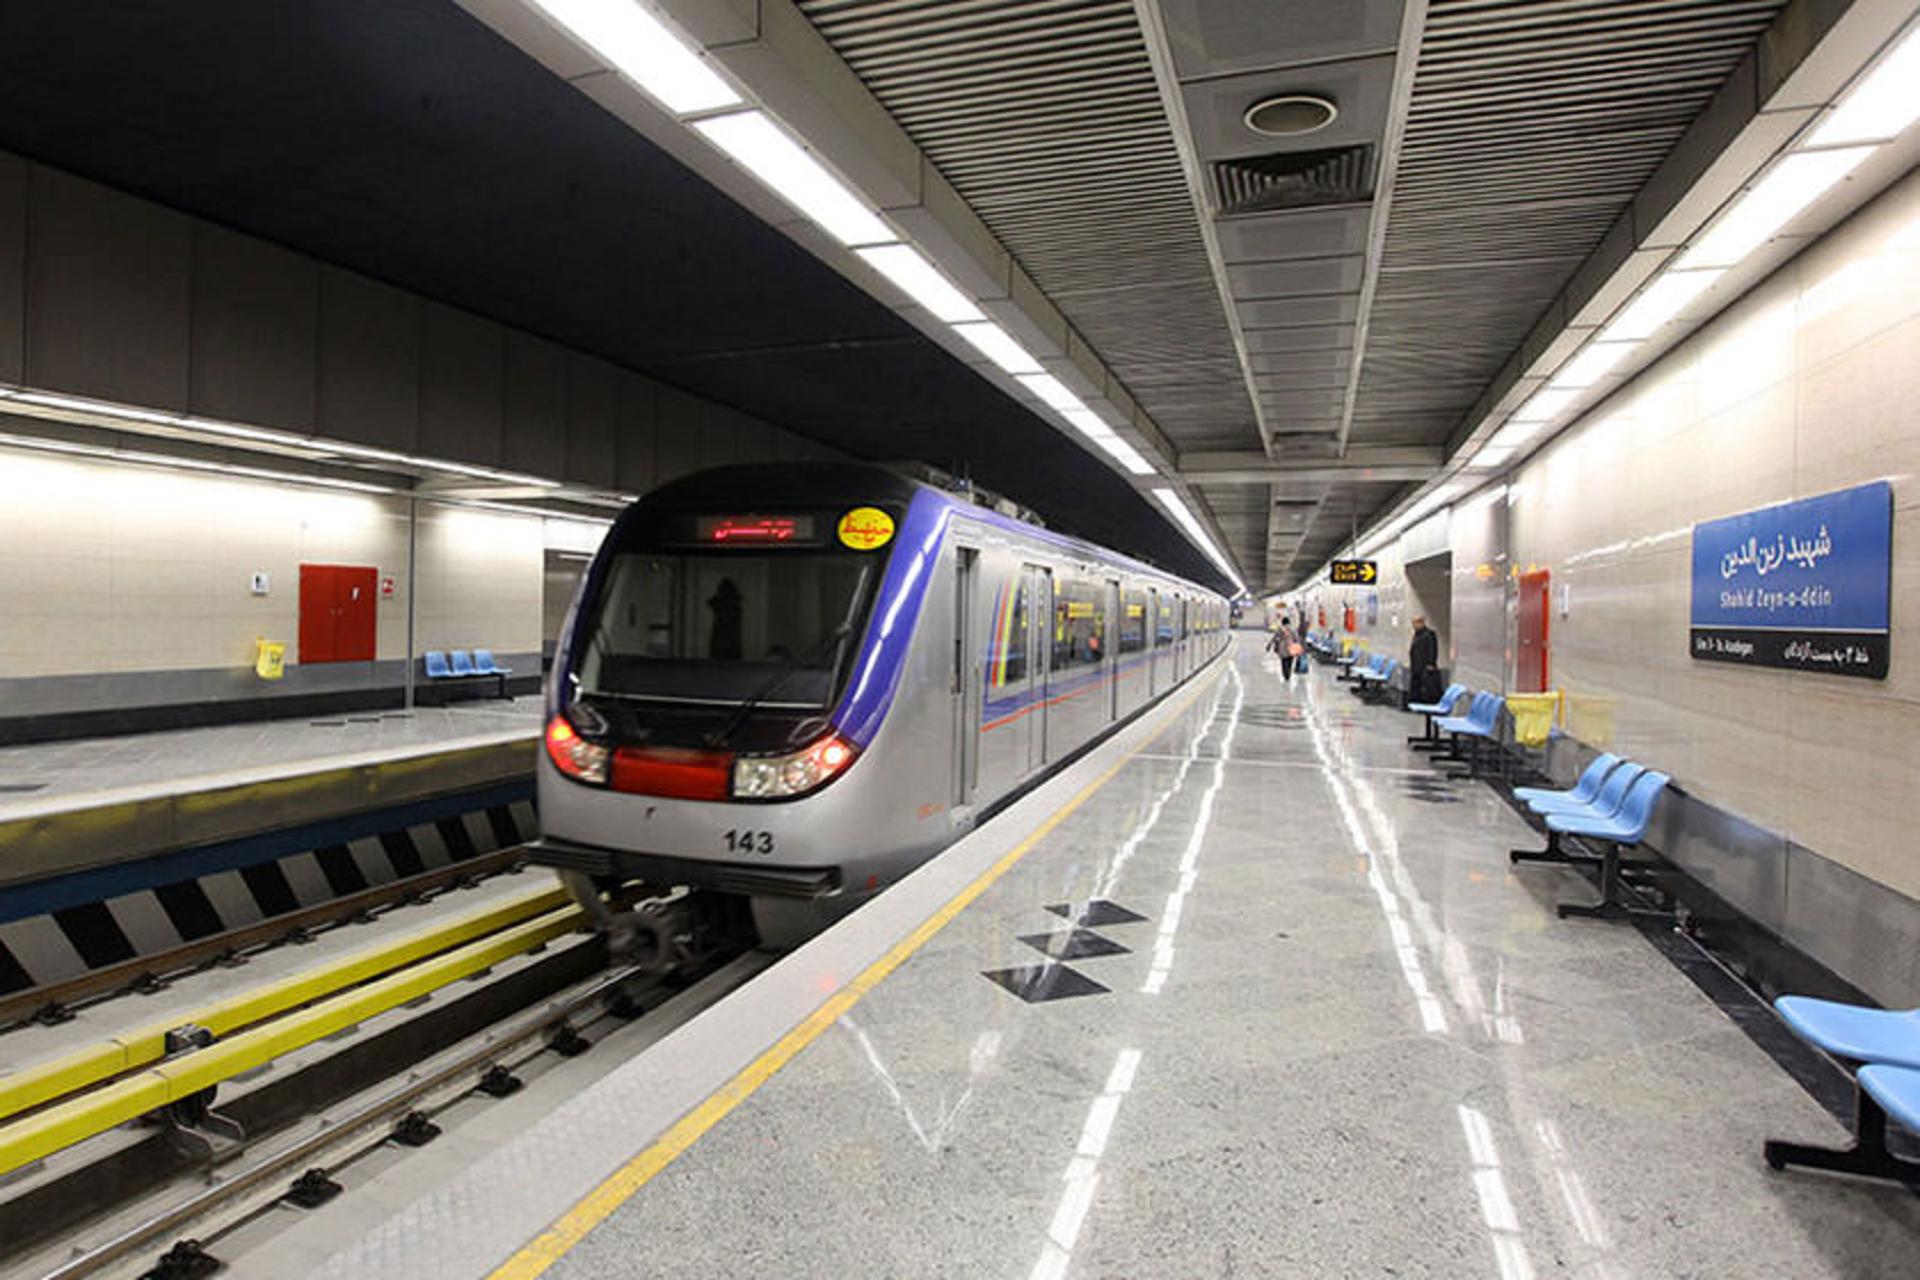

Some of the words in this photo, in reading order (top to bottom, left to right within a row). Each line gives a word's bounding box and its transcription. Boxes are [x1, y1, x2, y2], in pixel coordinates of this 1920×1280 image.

[1786, 524, 1832, 568] شهید
[1720, 588, 1754, 609] Shahid
[723, 829, 775, 855] 143
